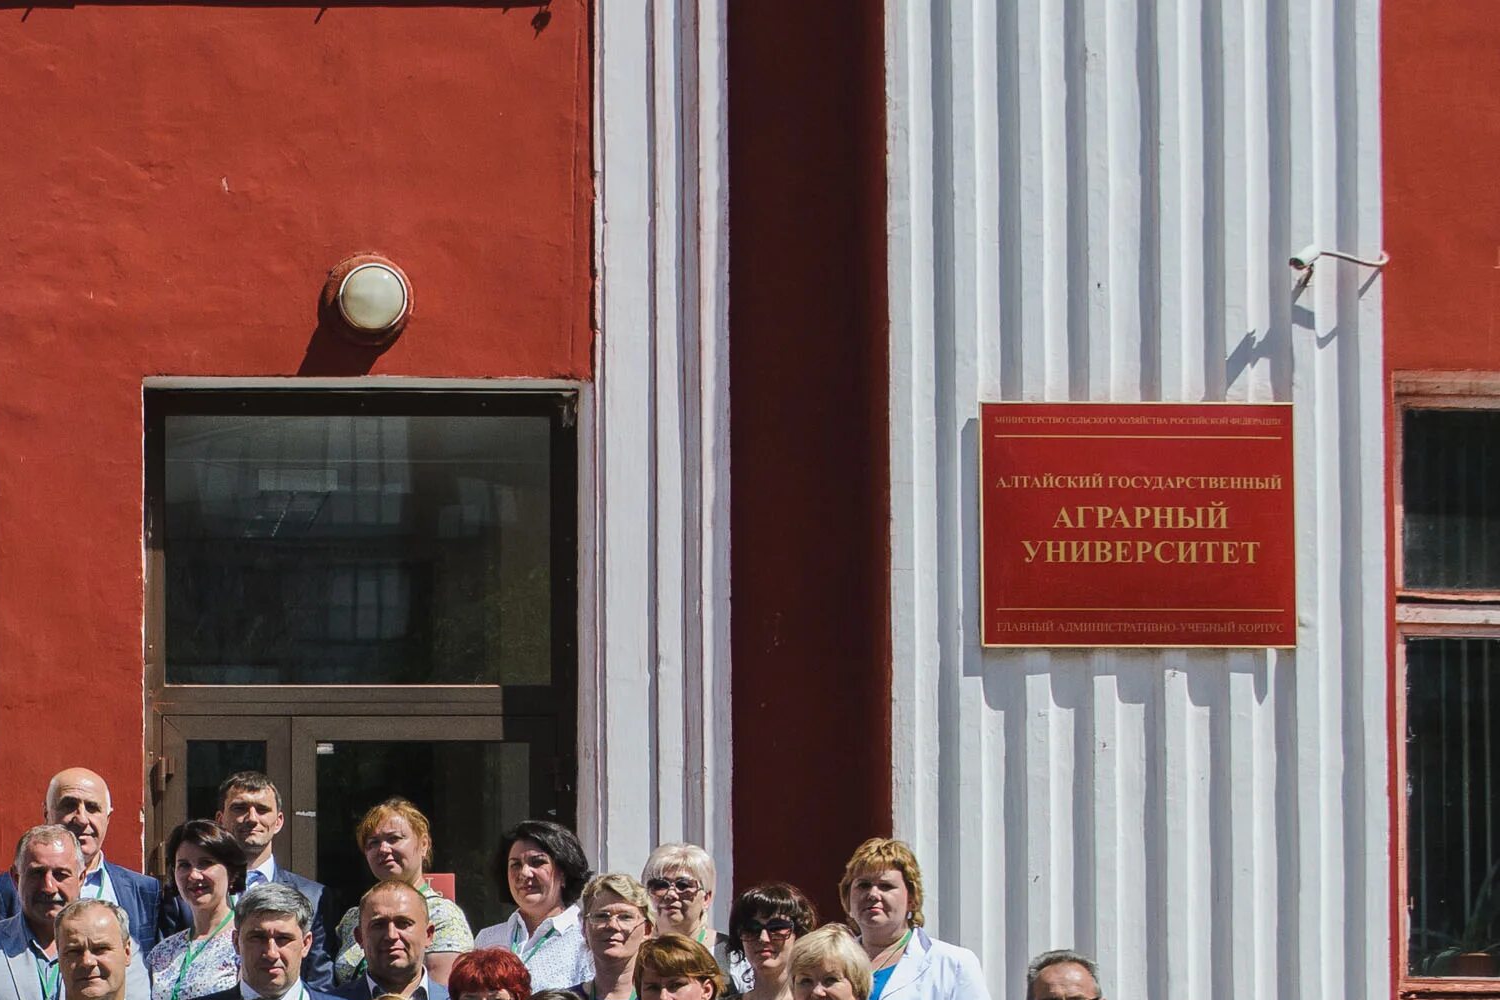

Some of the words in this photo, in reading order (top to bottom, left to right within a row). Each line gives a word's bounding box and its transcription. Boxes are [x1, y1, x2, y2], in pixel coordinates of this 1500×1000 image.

[1117, 416, 1168, 425] ХОЗЯЙСТВА
[1170, 416, 1228, 425] РОССИЙСКОЙ
[1229, 417, 1282, 426] ФЕДЕРАЦИИ
[996, 474, 1102, 489] АЛТАЙСКИЙ
[1108, 474, 1282, 491] ГОСУДАРСТВЕННЫЙ
[1052, 501, 1228, 529] АГРАРНЫЙ
[1021, 540, 1260, 564] УНИВЕРСИТЕТ
[997, 621, 1054, 632] ГЛАВНЫЙ
[1057, 621, 1235, 634] АДМИНИСТРАТИВНО-УЧЕБНЫЙ
[1237, 623, 1284, 633] КОРПУС
